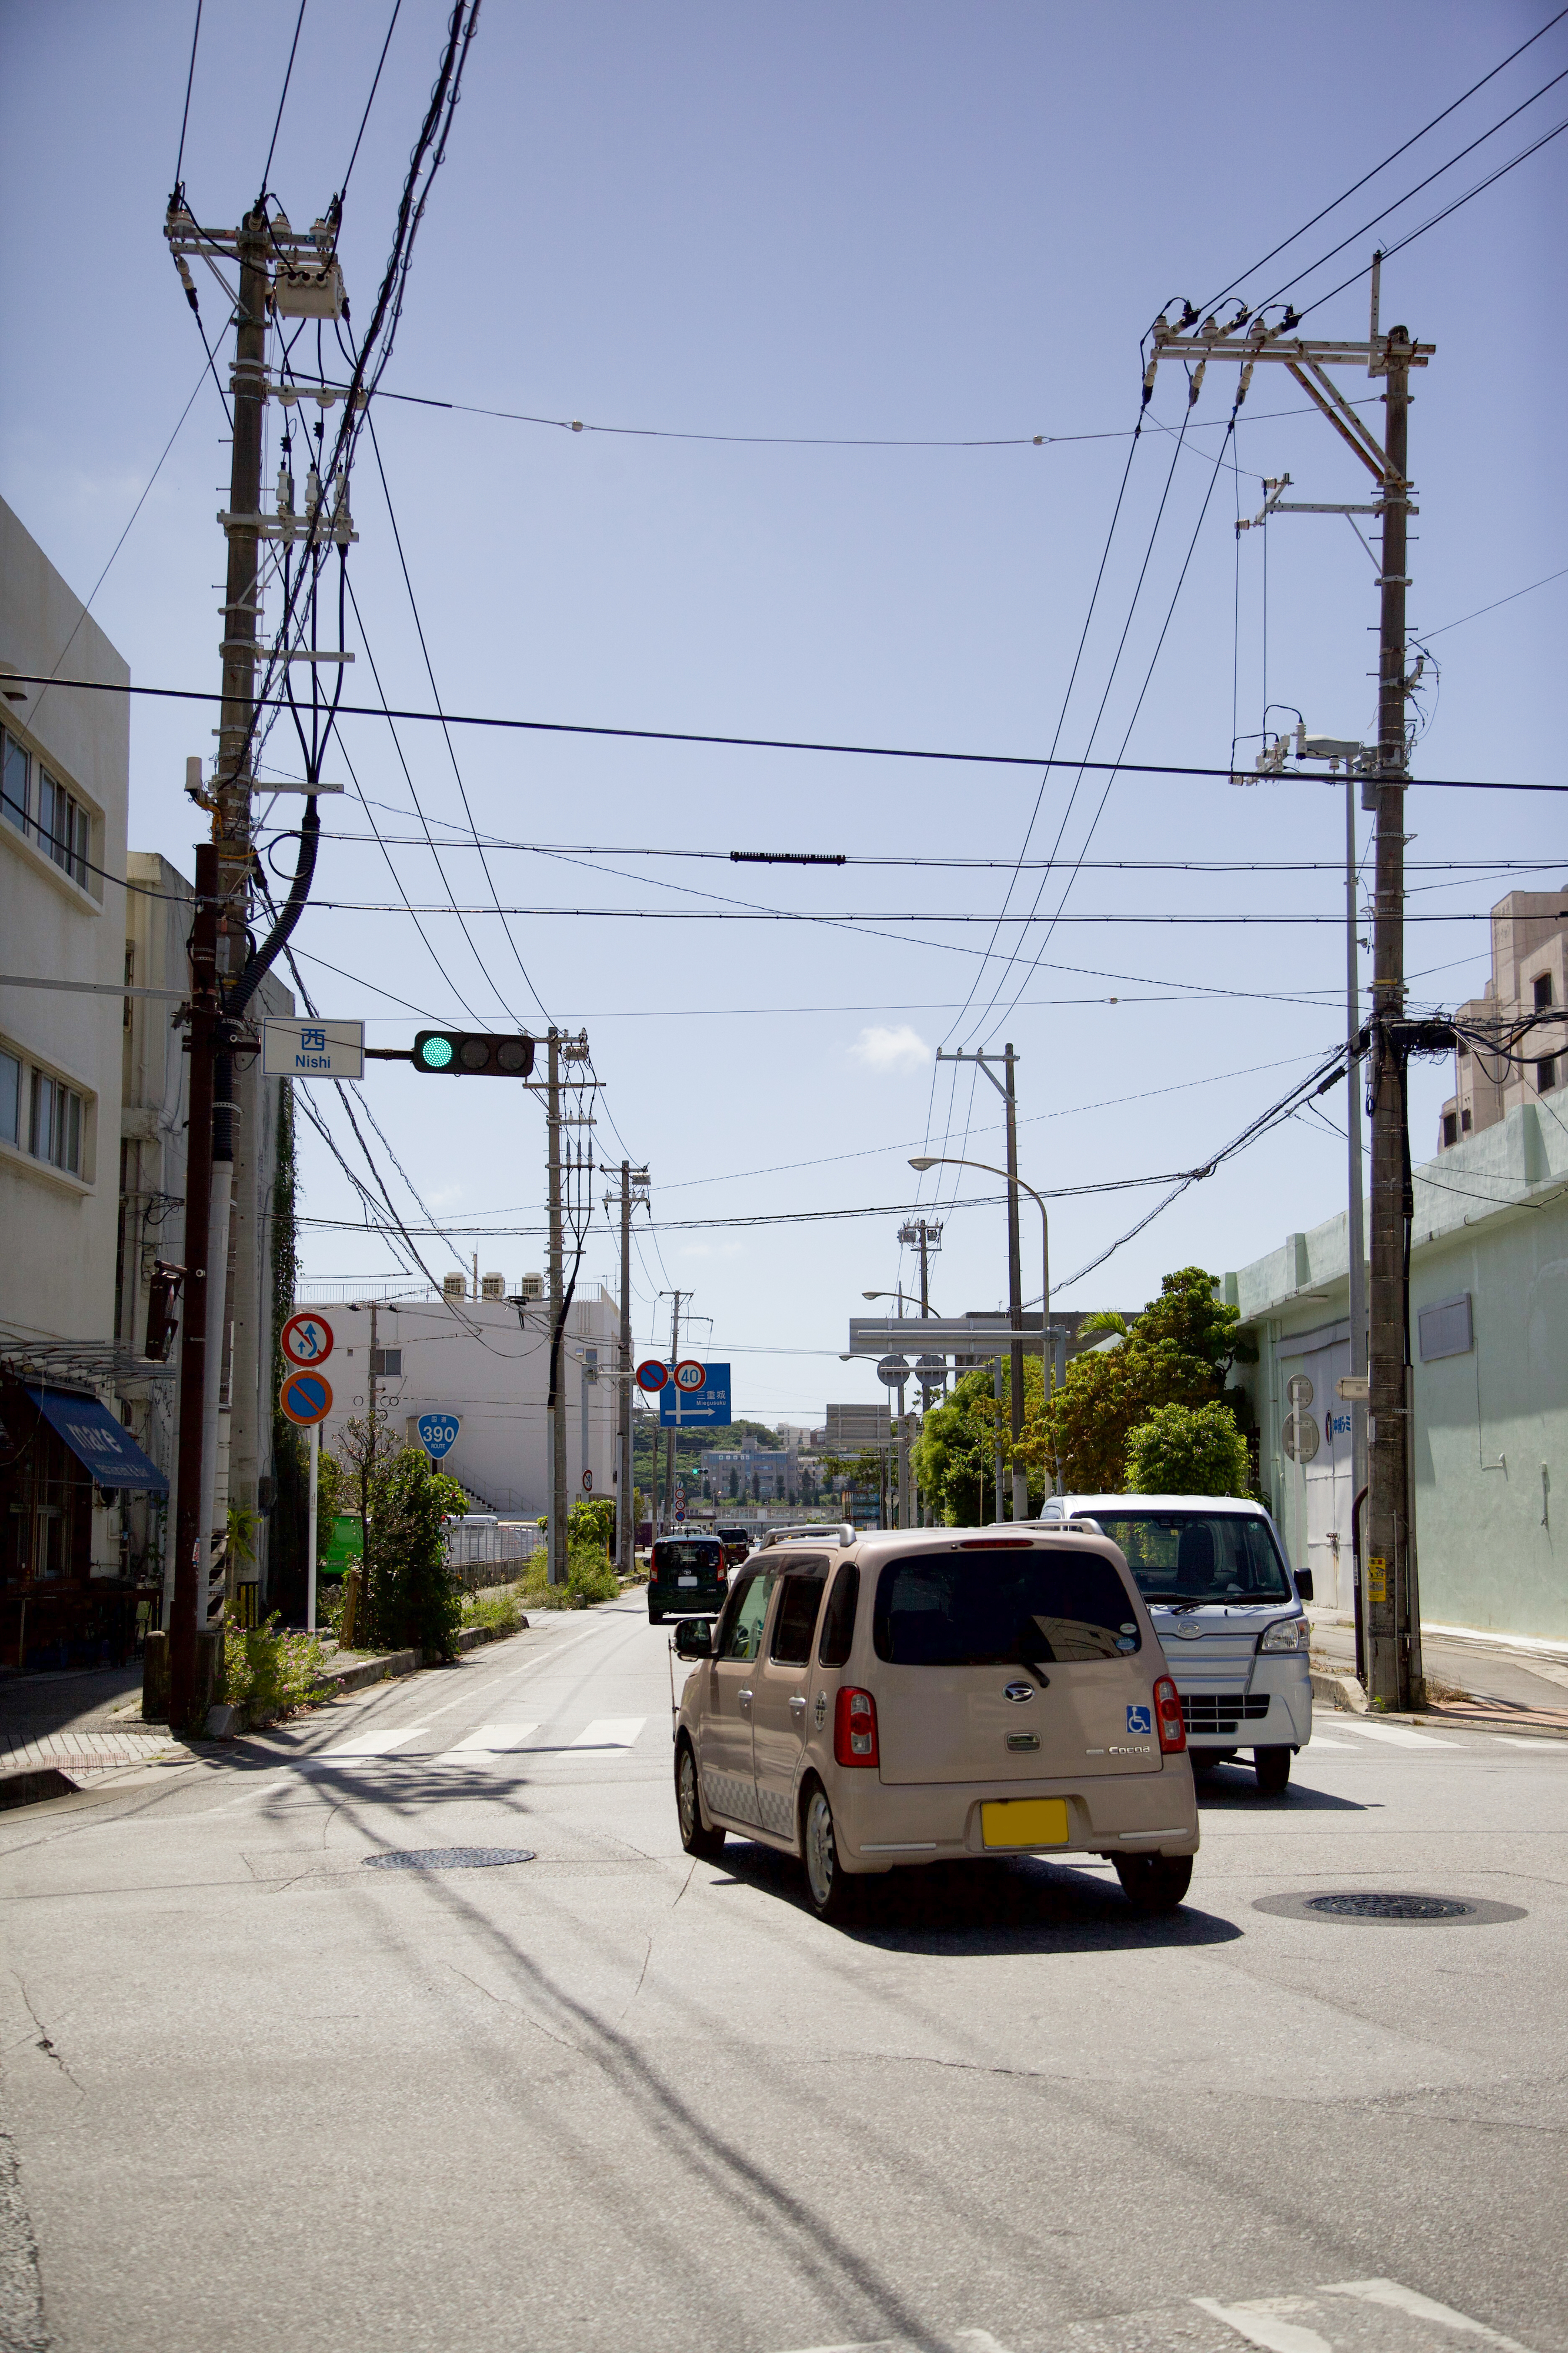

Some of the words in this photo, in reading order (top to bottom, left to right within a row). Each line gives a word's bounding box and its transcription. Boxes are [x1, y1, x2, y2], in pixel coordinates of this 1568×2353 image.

[301, 1028, 326, 1051] 西
[295, 1055, 331, 1068] Nishi
[681, 1369, 698, 1383] 40
[697, 1390, 726, 1399] 三重城
[66, 1423, 123, 1454] mare
[423, 1426, 455, 1442] 390
[1109, 1746, 1150, 1755] Cocoa
